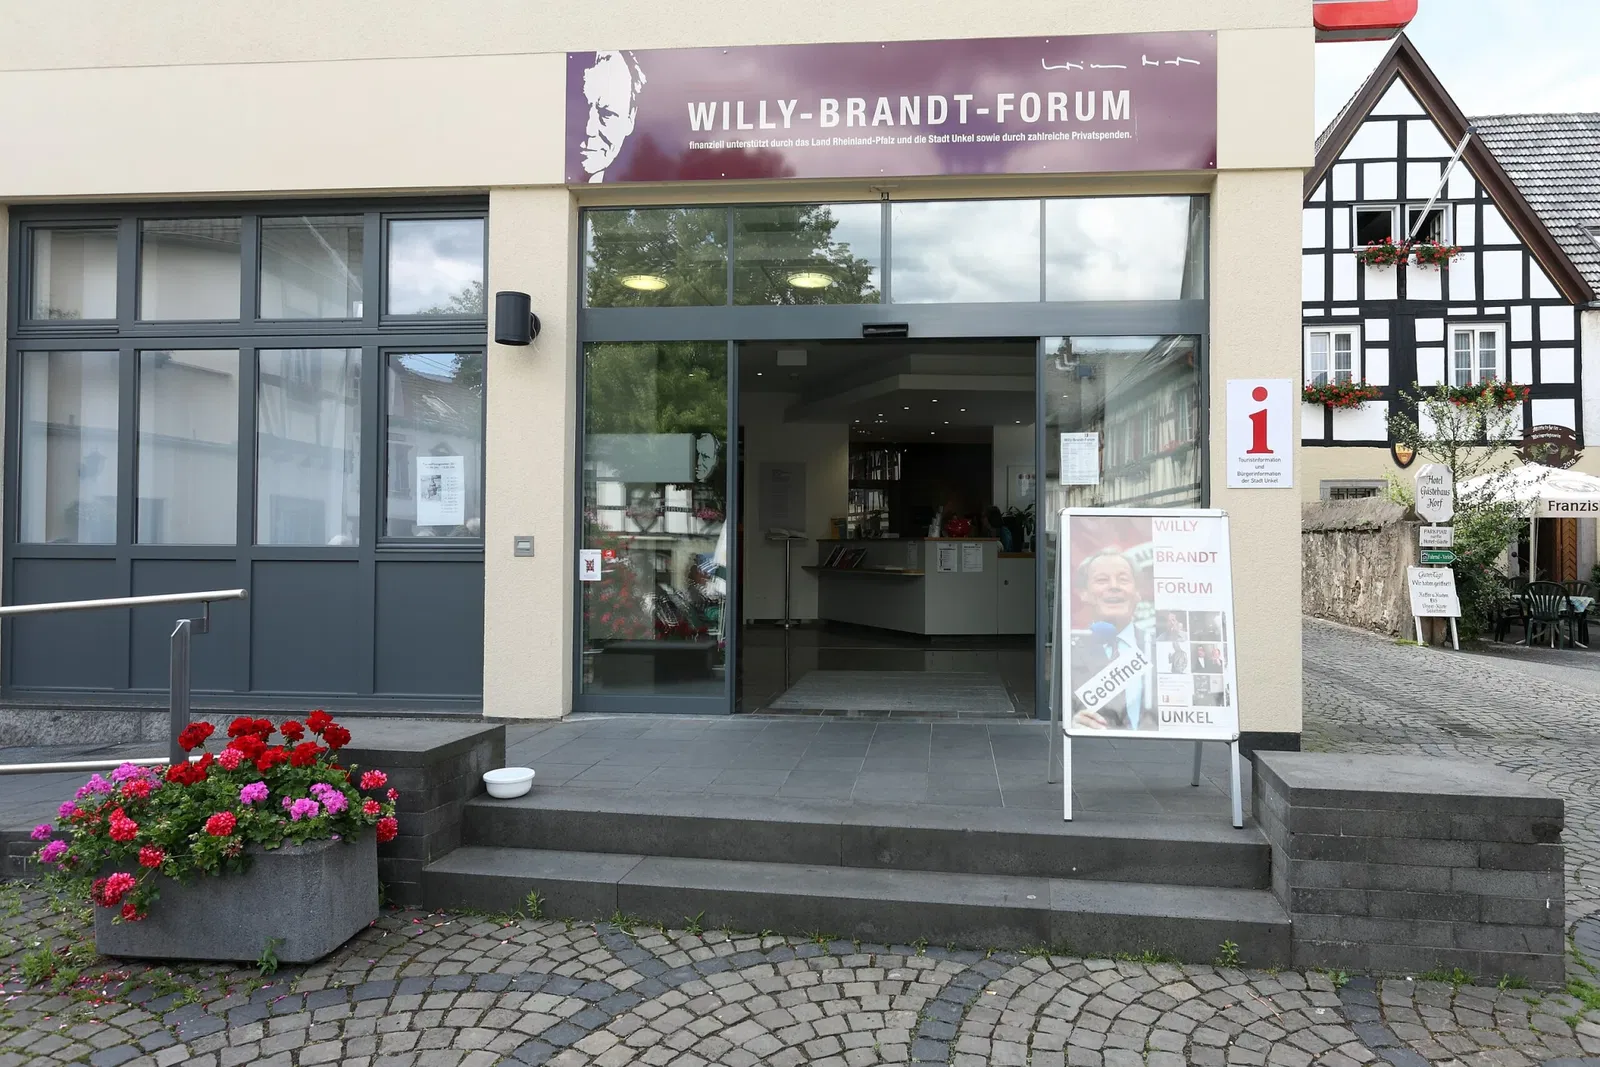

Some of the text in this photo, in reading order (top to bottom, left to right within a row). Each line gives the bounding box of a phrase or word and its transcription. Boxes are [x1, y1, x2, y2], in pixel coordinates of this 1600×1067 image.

[688, 90, 1130, 131] WILLY-BRANDT-FORUM
[689, 131, 1132, 149] finanziell unterstützt durch das Land Rheinland-Pfalz und die Stadt Unkel sowie durch zahlreiche Privatspenden.
[1426, 475, 1443, 485] Hotel
[1548, 500, 1598, 512] Franzis
[1154, 520, 1199, 532] WILLY
[1155, 551, 1218, 563] BRANDT
[1156, 582, 1213, 594] FORUM
[1082, 652, 1148, 706] Geöffnet
[1161, 710, 1214, 724] UNKEL
